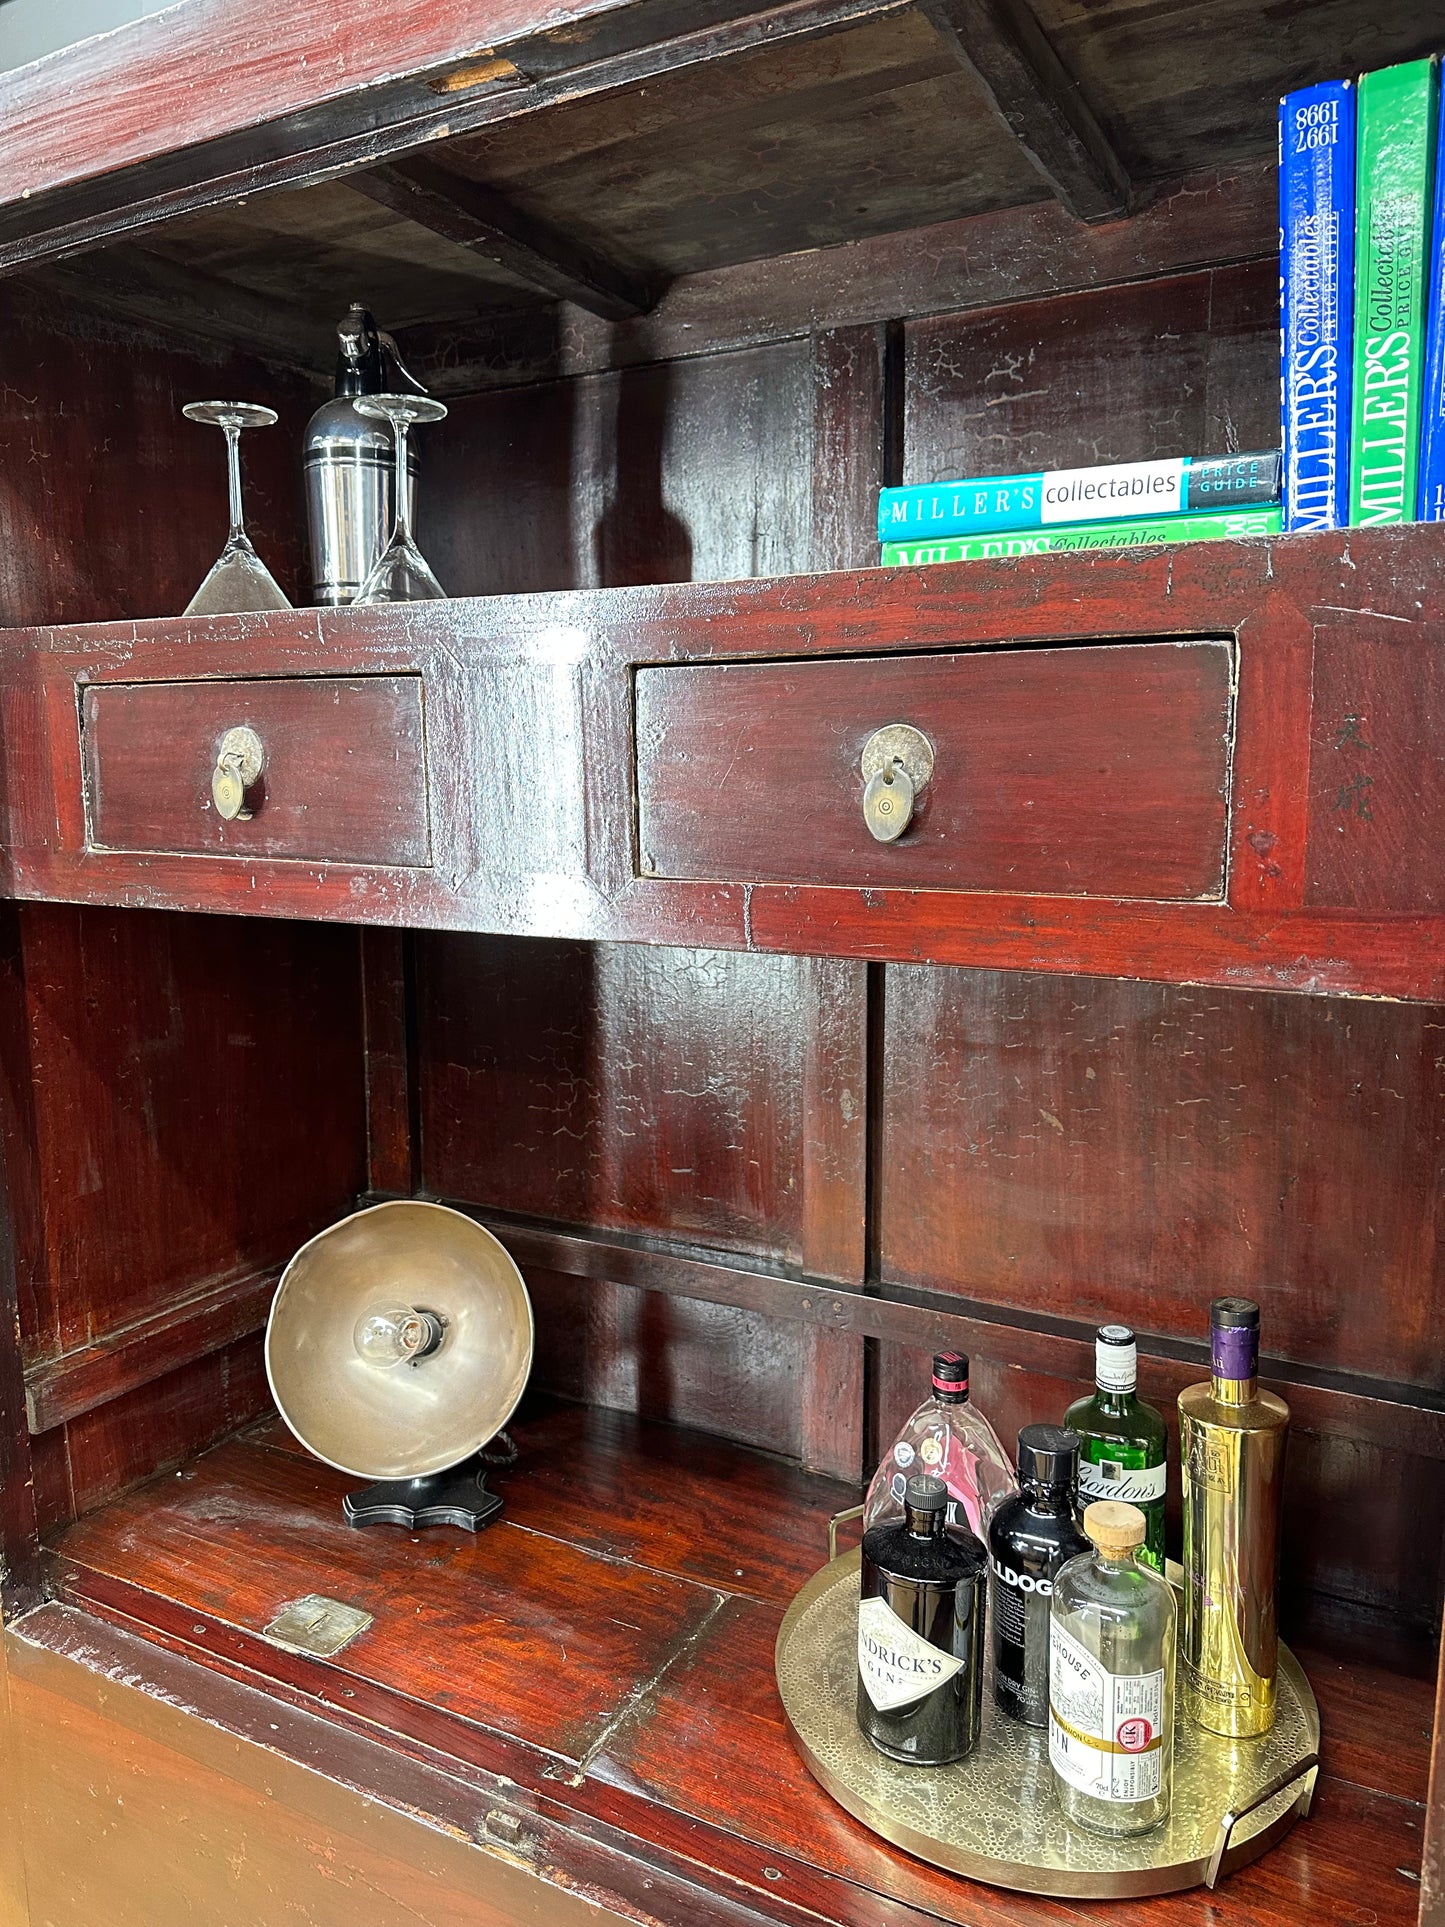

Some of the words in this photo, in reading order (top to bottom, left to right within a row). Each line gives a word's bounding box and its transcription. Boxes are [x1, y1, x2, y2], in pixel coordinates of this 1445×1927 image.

[1296, 100, 1340, 129] 1998
[1296, 123, 1339, 153] 1997
[1297, 214, 1321, 346] Collectables
[1369, 199, 1395, 333] Collectabl
[1397, 265, 1411, 329] PRICE
[1293, 344, 1338, 532] MILLER'S
[1359, 331, 1411, 528] MILLER'S
[1200, 477, 1257, 492] GUIDE
[1201, 461, 1258, 479] PRICE
[891, 486, 1035, 523] MILLER'S
[1046, 474, 1176, 503] collectables
[867, 1660, 895, 1684] GIN
